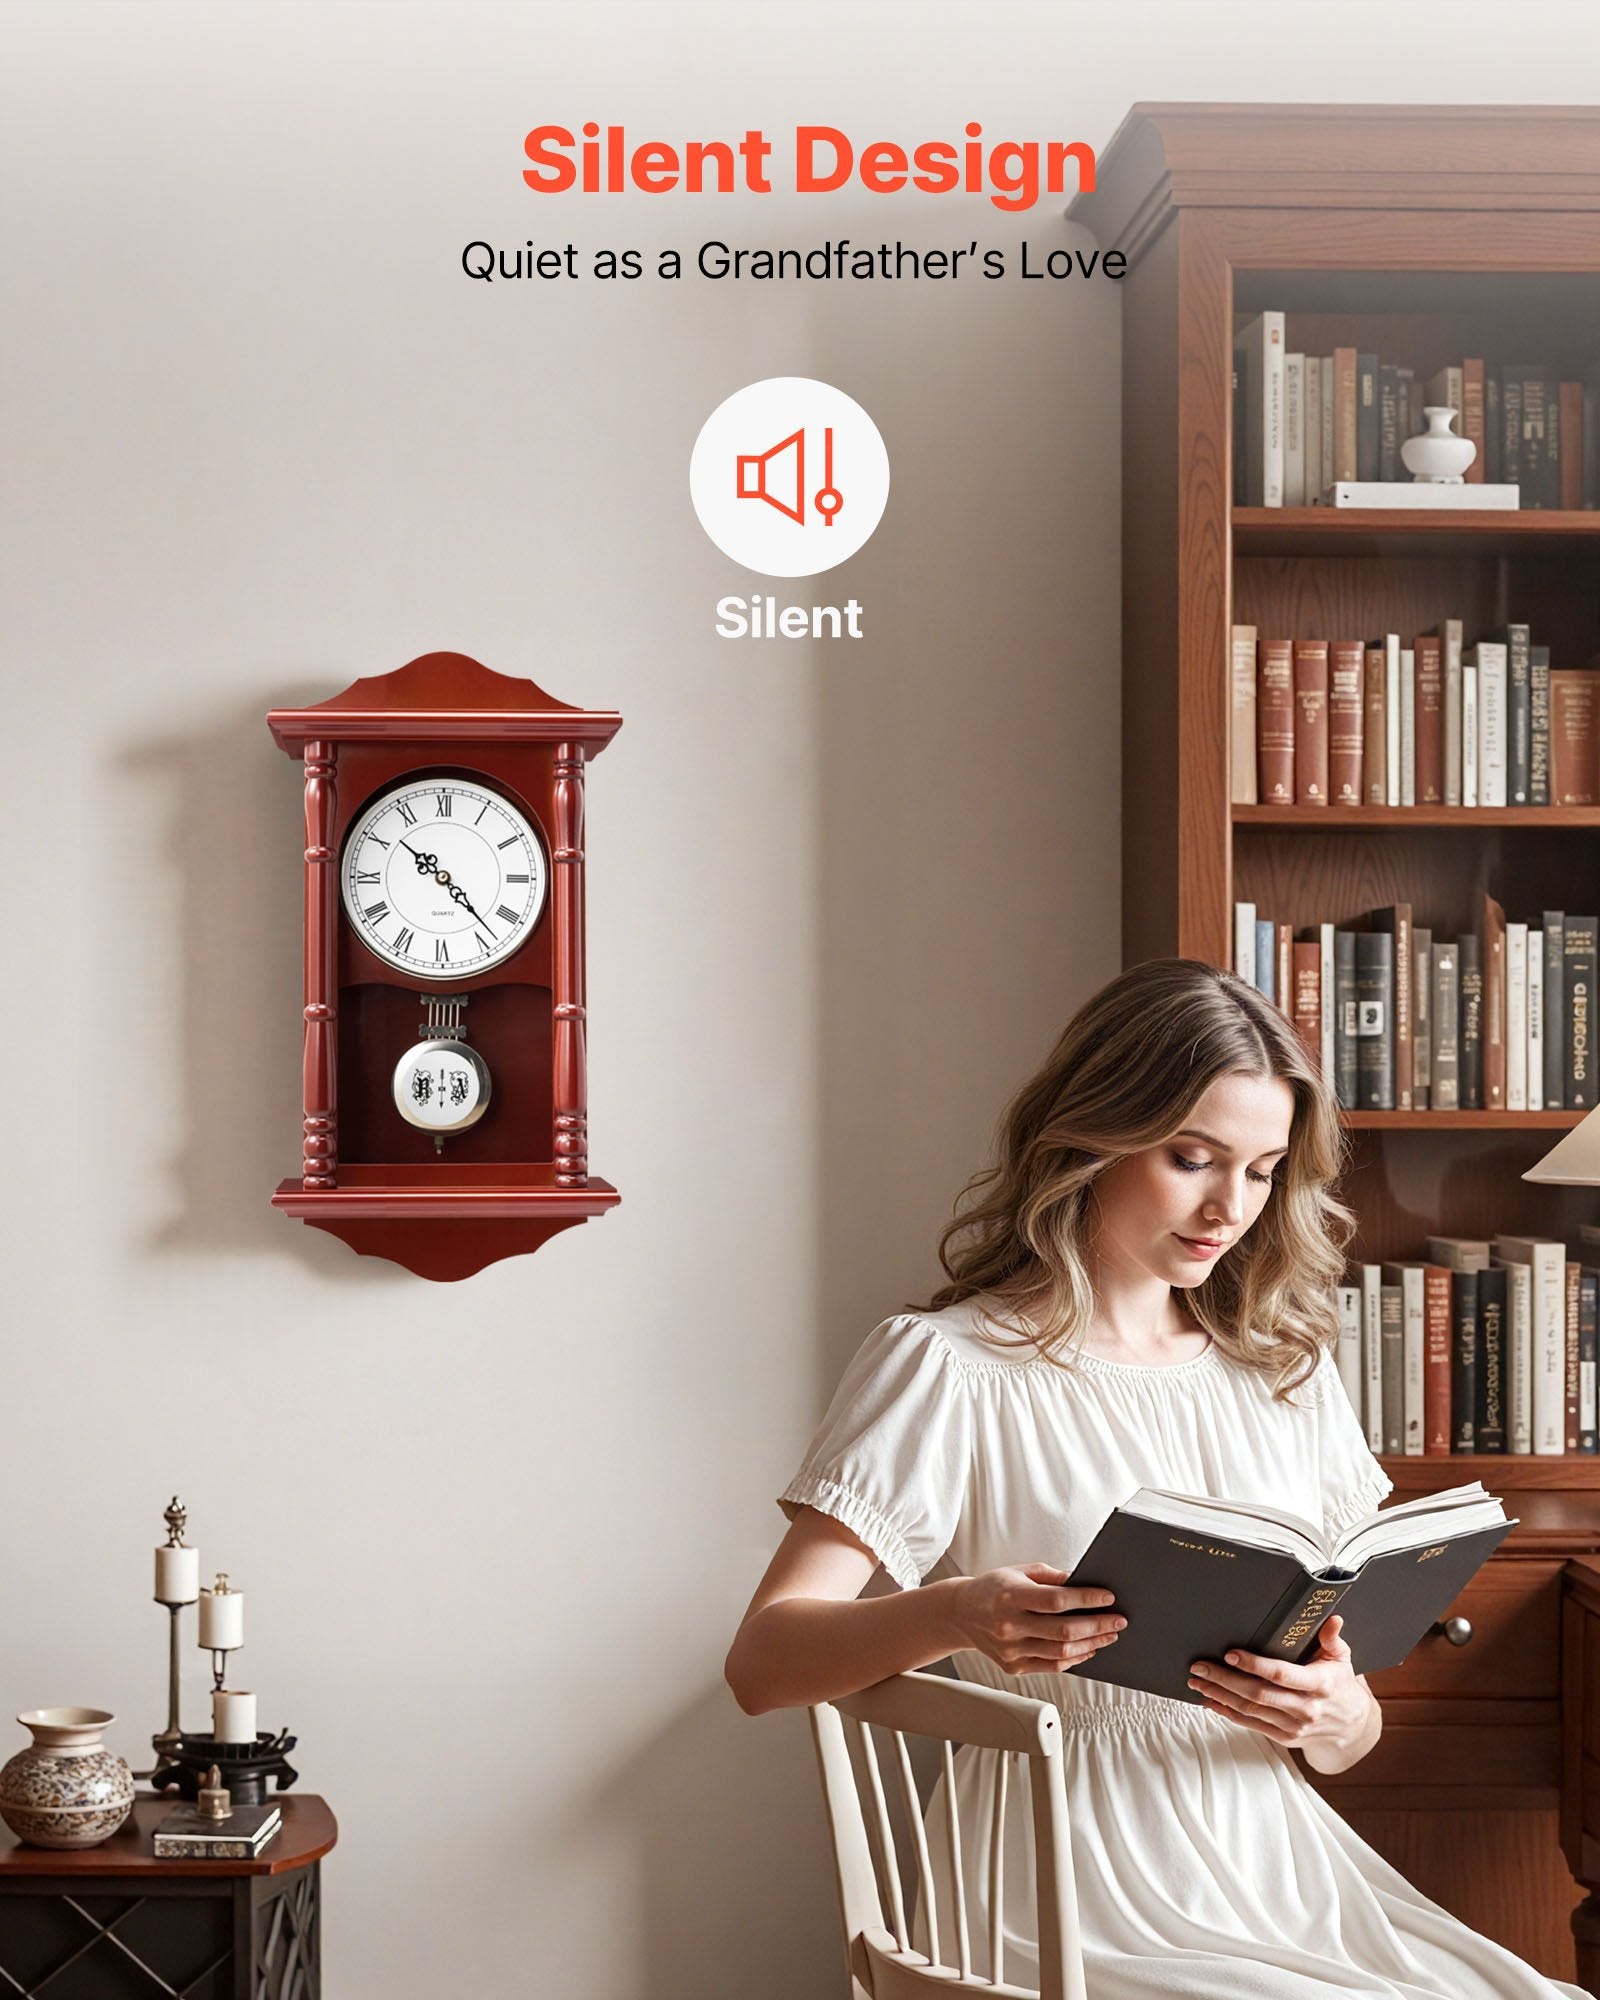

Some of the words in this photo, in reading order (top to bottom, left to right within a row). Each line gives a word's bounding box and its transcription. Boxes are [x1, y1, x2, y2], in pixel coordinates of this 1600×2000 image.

[396, 802, 418, 828] XI
[435, 795, 452, 817] XII
[367, 832, 391, 851] X
[497, 835, 519, 851] II
[357, 870, 381, 885] IX
[435, 939, 450, 962] VI
[474, 931, 490, 953] V
